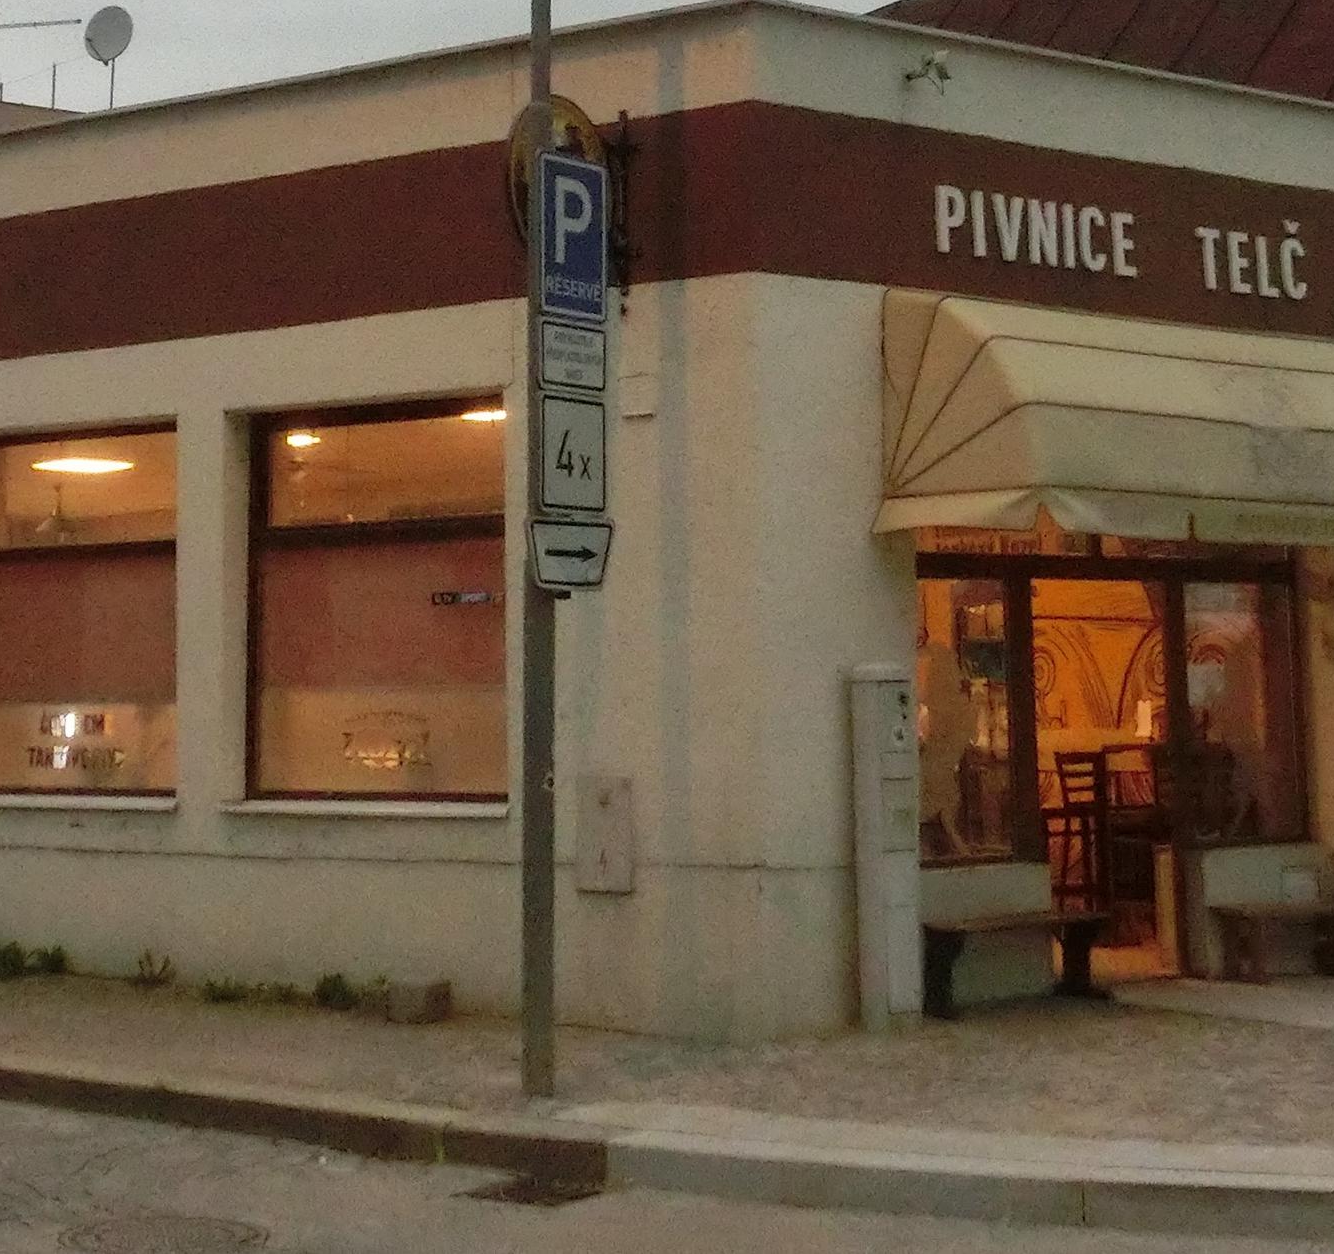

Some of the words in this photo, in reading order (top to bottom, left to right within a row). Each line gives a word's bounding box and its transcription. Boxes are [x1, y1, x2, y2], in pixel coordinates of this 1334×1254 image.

[555, 175, 592, 264] P
[932, 183, 1139, 278] PIVNICE
[1193, 220, 1309, 301] TELČ
